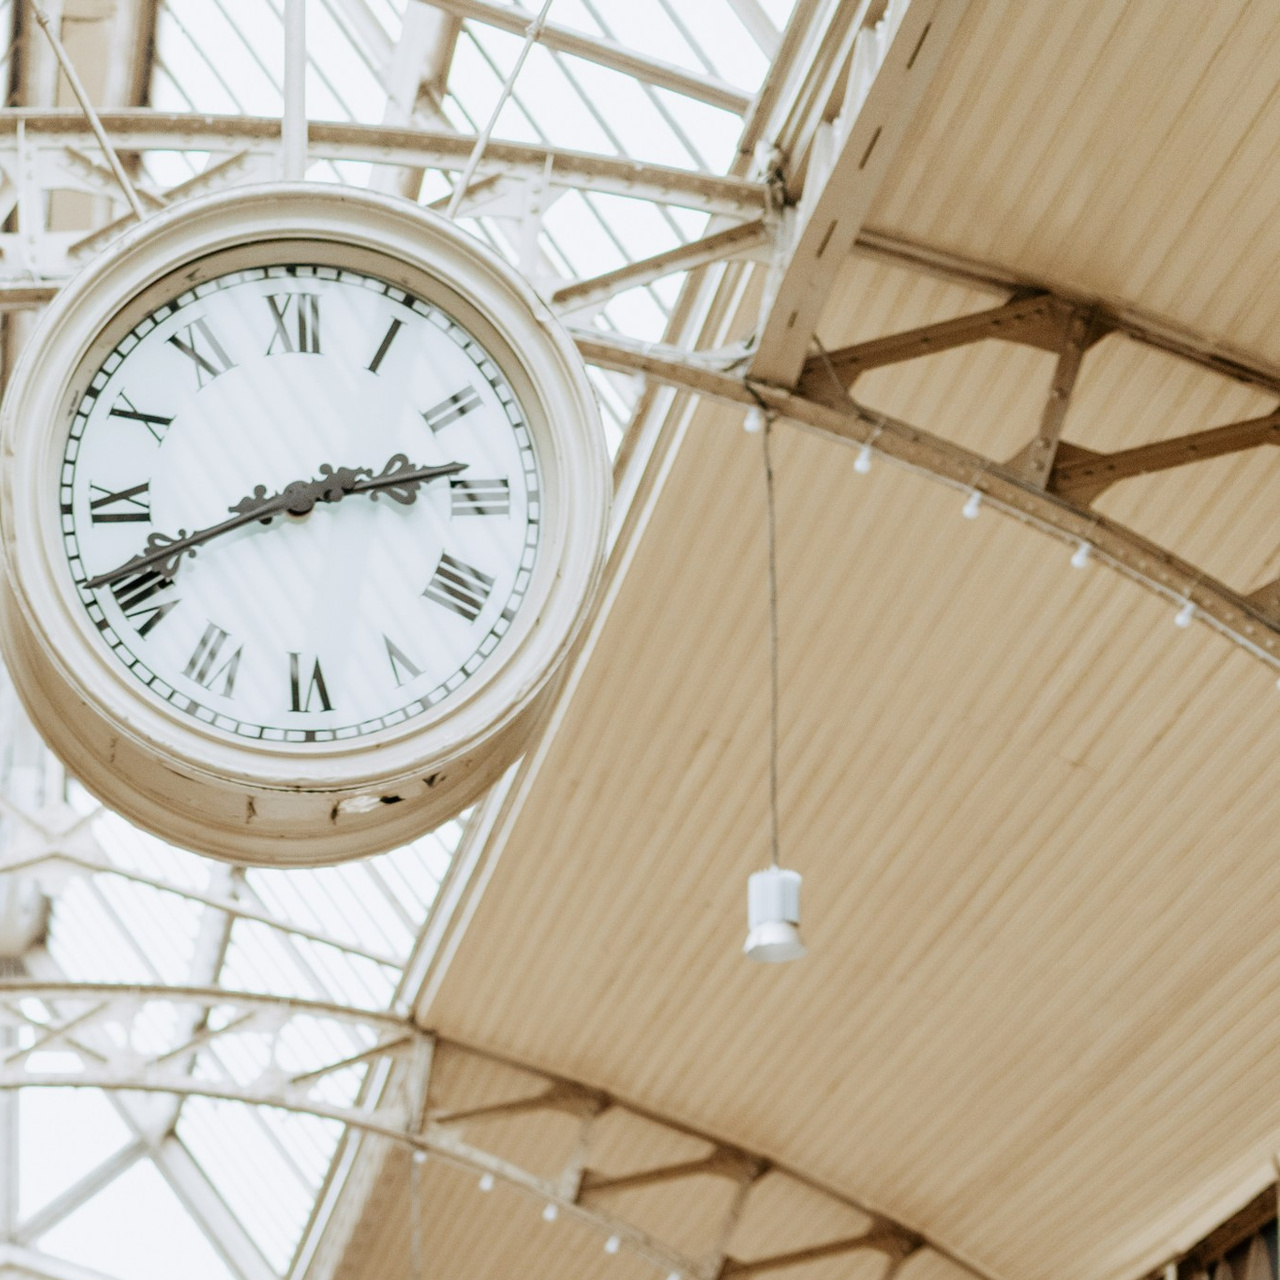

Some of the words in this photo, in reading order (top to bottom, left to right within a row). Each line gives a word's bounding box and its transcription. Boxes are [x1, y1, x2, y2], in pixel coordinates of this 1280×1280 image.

[265, 293, 322, 356] XII
[364, 317, 407, 374] I
[167, 317, 237, 390] XI
[108, 389, 176, 446] X
[422, 385, 483, 433] II
[90, 480, 151, 527] IX
[449, 476, 510, 520] III
[422, 549, 495, 625] IIII
[181, 620, 243, 699] VII
[287, 652, 336, 713] VI
[382, 634, 426, 687] V
